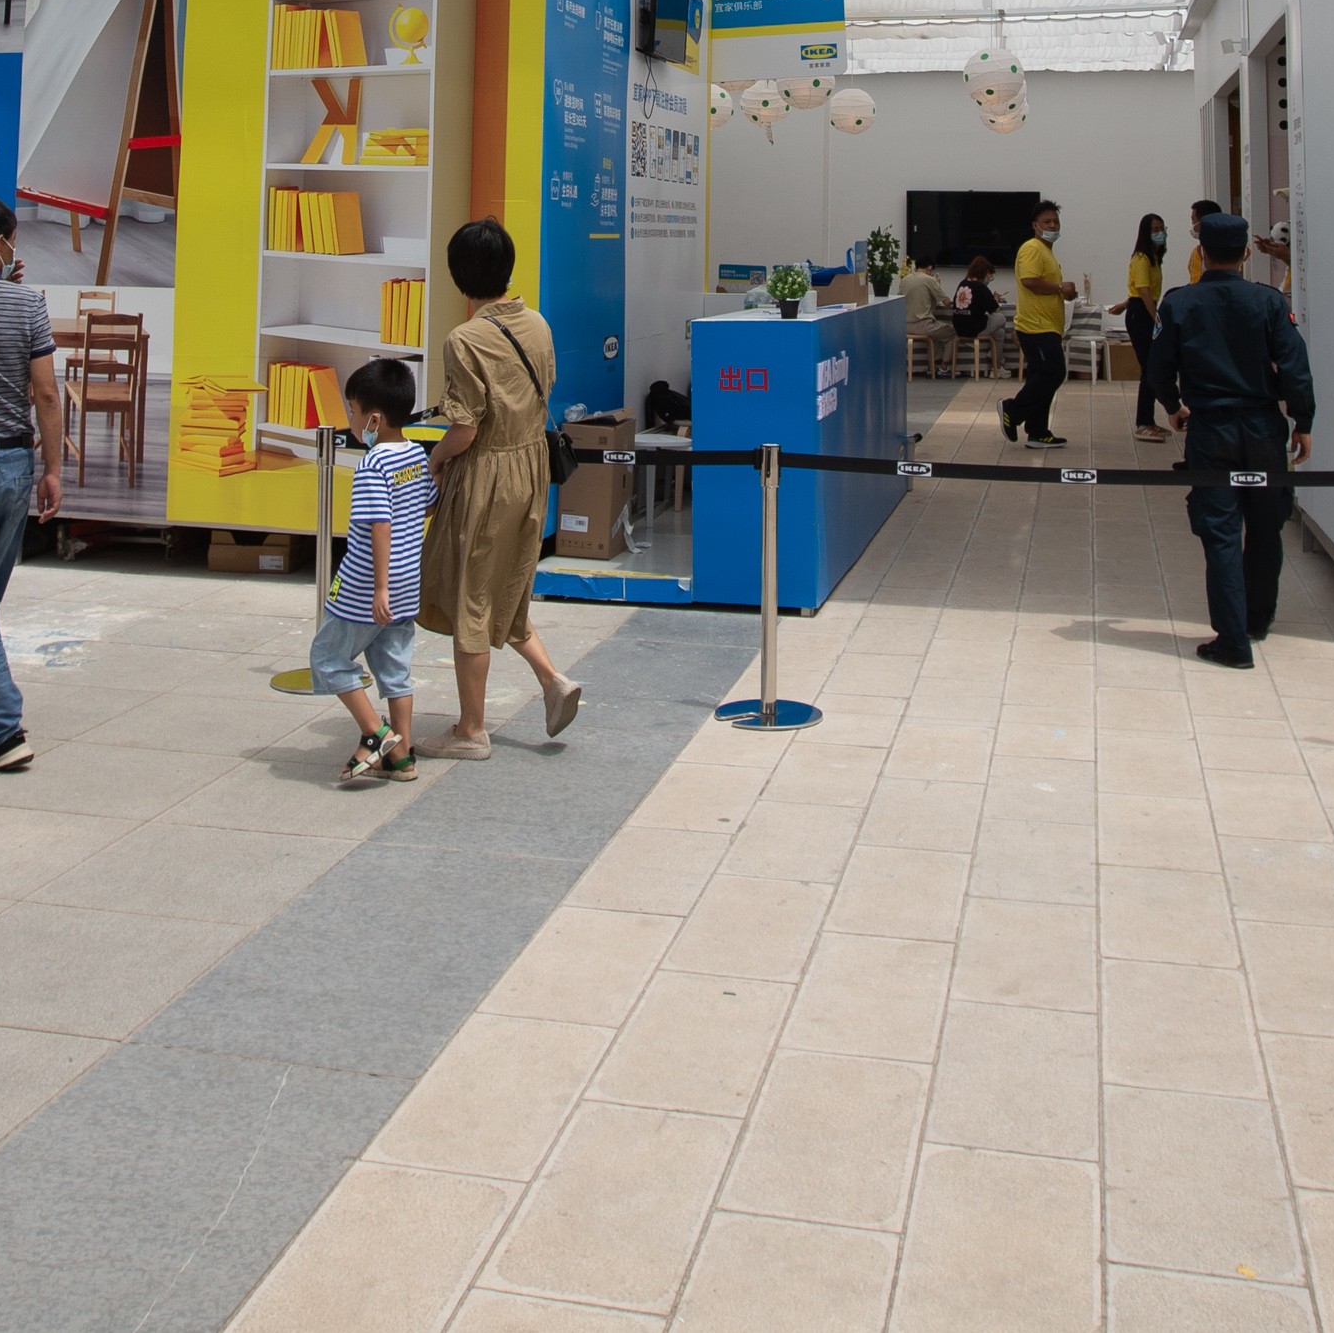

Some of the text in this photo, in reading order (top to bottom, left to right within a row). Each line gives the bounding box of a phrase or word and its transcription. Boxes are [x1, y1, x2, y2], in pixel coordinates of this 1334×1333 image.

[715, 1, 763, 13] 宜家俱乐部
[804, 48, 834, 56] IKEA
[604, 342, 618, 354] IKEA
[719, 366, 769, 392] 出口
[606, 453, 633, 461] IKEA
[900, 465, 929, 474] IKEA
[1064, 472, 1094, 481] IKEA
[1233, 474, 1265, 483] IKEA
